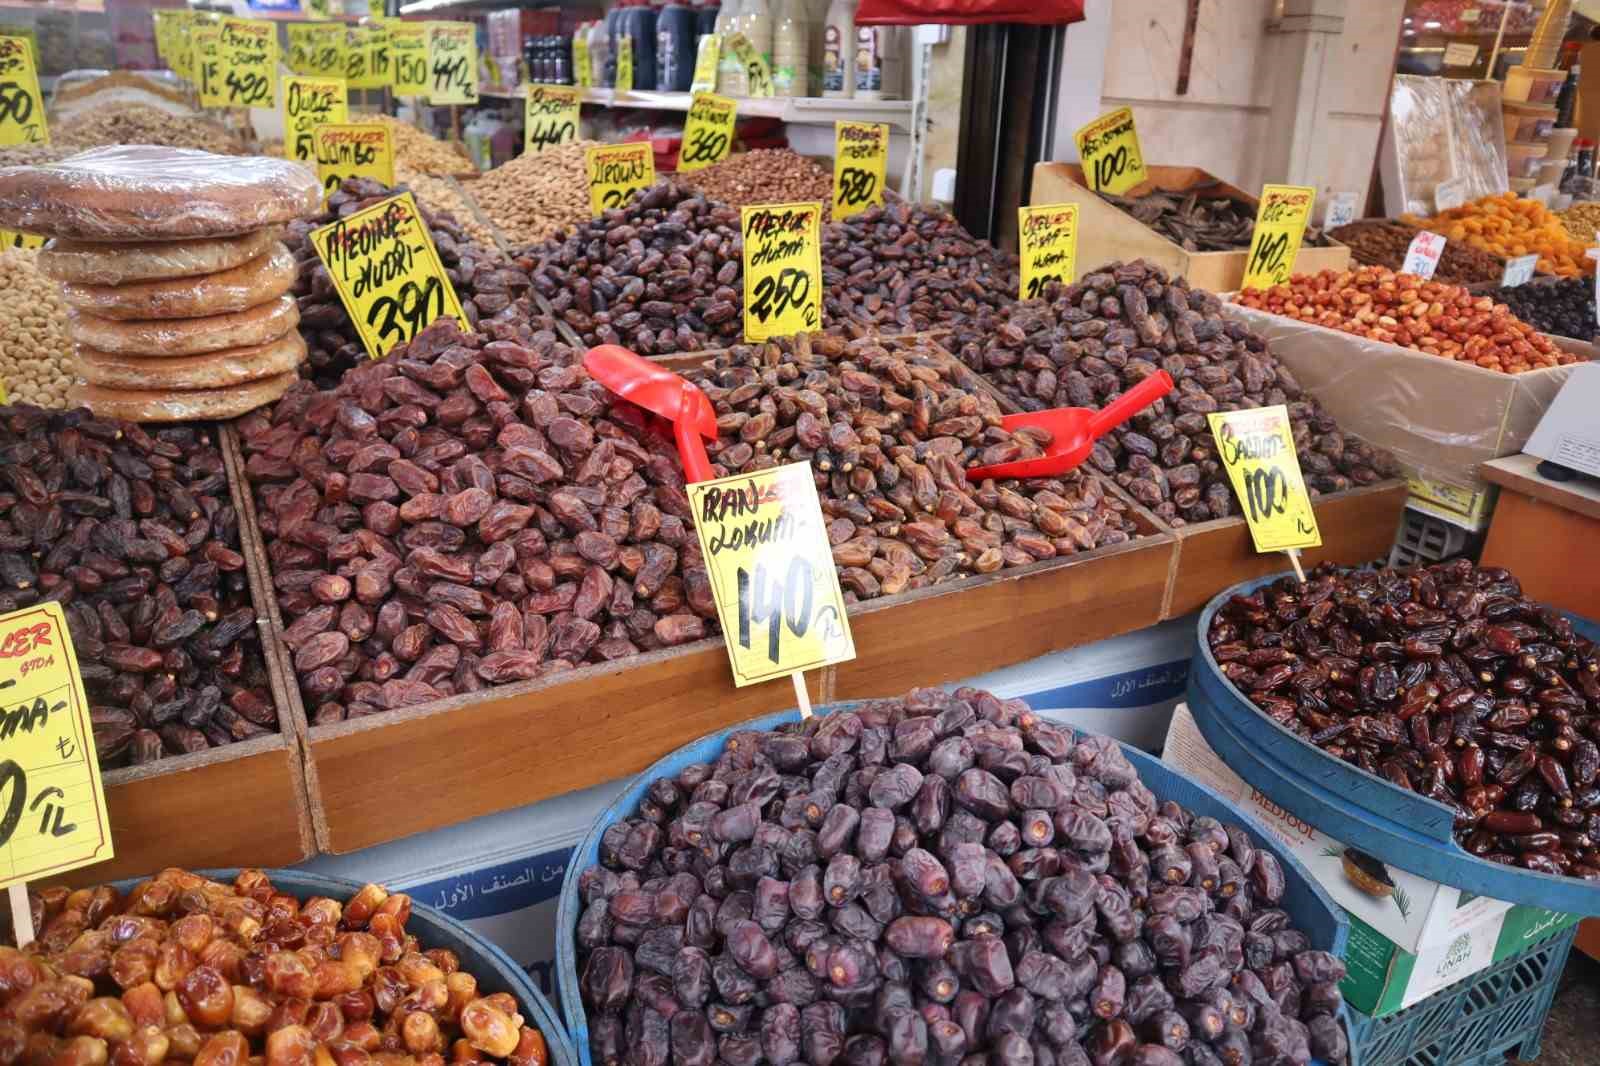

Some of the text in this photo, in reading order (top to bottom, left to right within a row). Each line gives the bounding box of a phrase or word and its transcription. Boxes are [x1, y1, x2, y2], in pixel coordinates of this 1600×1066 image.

[682, 128, 727, 162] 360
[1095, 144, 1127, 192] 100
[838, 167, 876, 206] 580
[1248, 232, 1289, 276] 140
[748, 267, 810, 324] 250
[1242, 465, 1288, 523] 100
[736, 555, 814, 665] 140
[1251, 786, 1314, 842] MEDJOOL
[433, 862, 564, 911] من الصنف الأول
